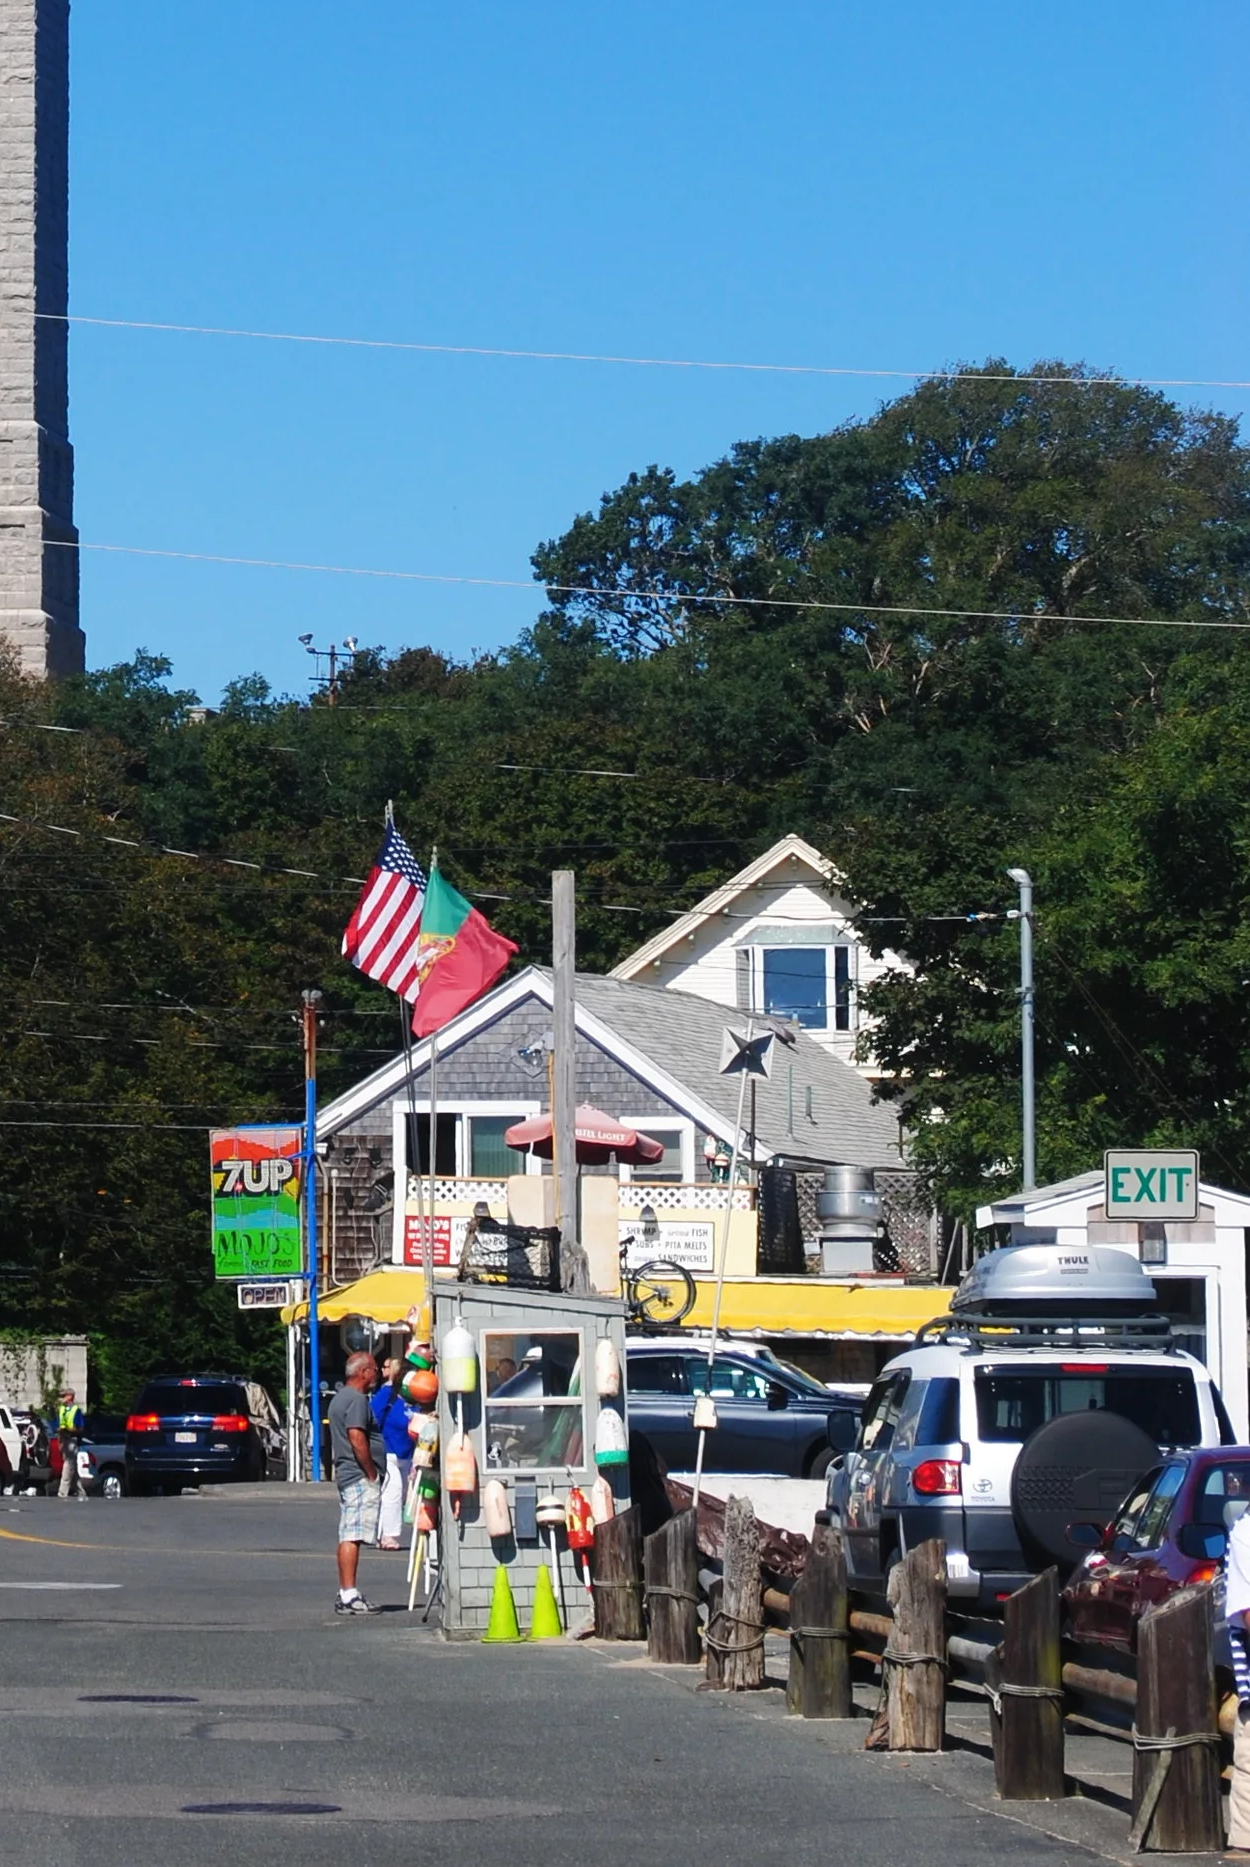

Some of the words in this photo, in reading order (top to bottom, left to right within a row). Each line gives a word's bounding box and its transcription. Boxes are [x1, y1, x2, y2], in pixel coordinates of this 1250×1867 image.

[598, 1131, 626, 1141] LIGHT
[222, 1159, 292, 1192] 7UP
[1111, 1167, 1192, 1202] EXIT
[626, 1226, 657, 1236] SHRIMP
[691, 1228, 708, 1237] FISH
[665, 1240, 681, 1249] PITA
[684, 1241, 707, 1250] MELTS
[273, 1258, 293, 1268] FOOD
[658, 1253, 708, 1263] SANDWICHES
[1057, 1256, 1089, 1265] THULE
[243, 1287, 285, 1305] OPEN
